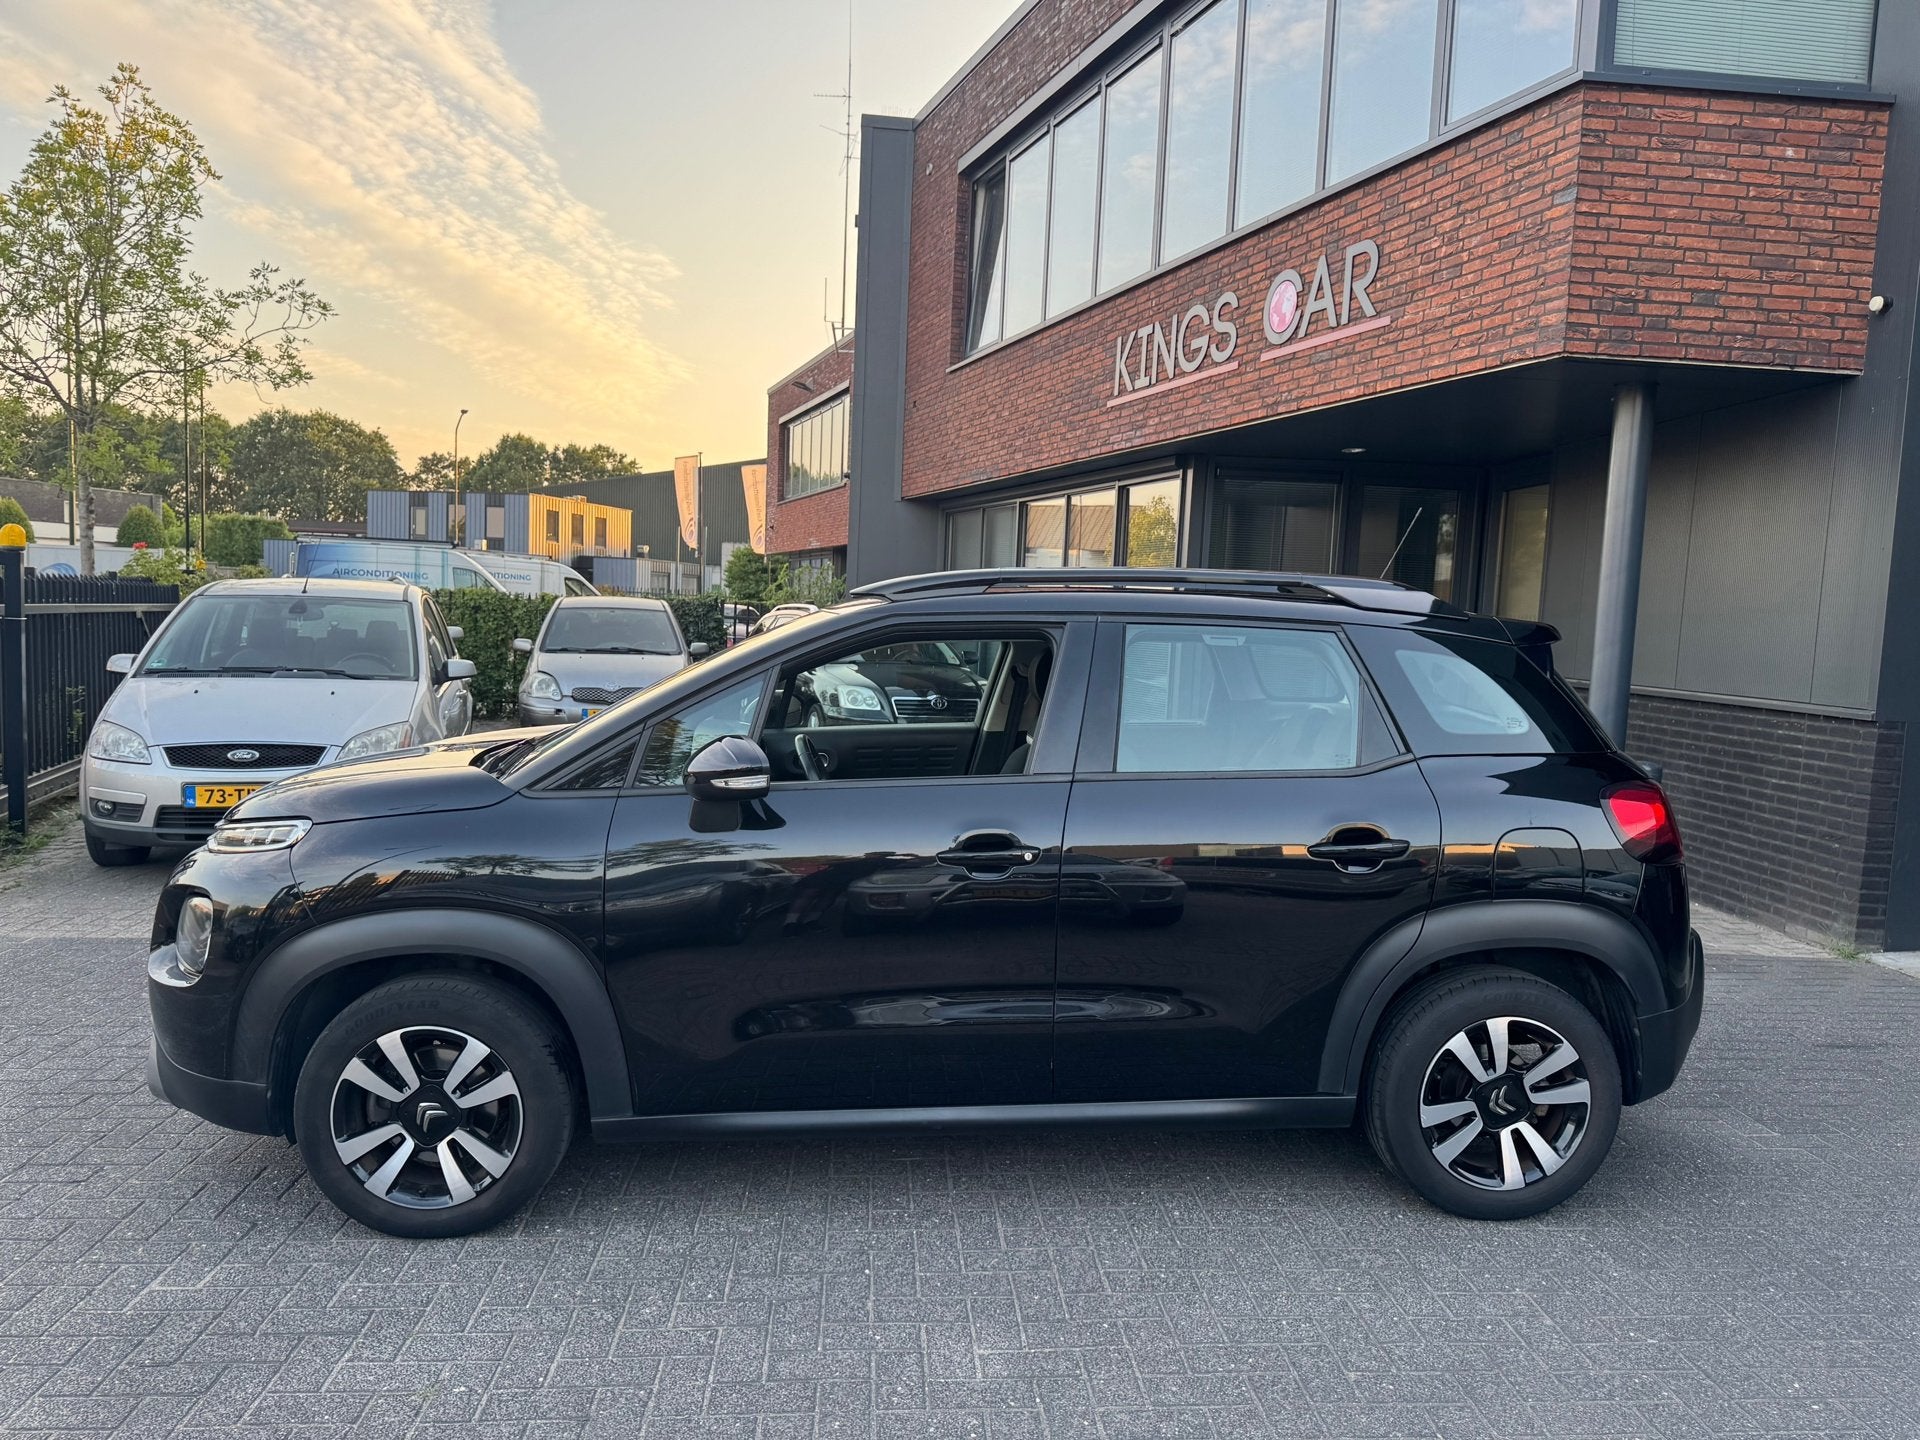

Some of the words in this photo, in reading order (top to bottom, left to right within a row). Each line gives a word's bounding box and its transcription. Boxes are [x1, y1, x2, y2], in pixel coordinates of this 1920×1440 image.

[1114, 291, 1239, 396] KINGS
[1263, 239, 1379, 345] CAR
[332, 567, 429, 580] AIRCONDITIONING
